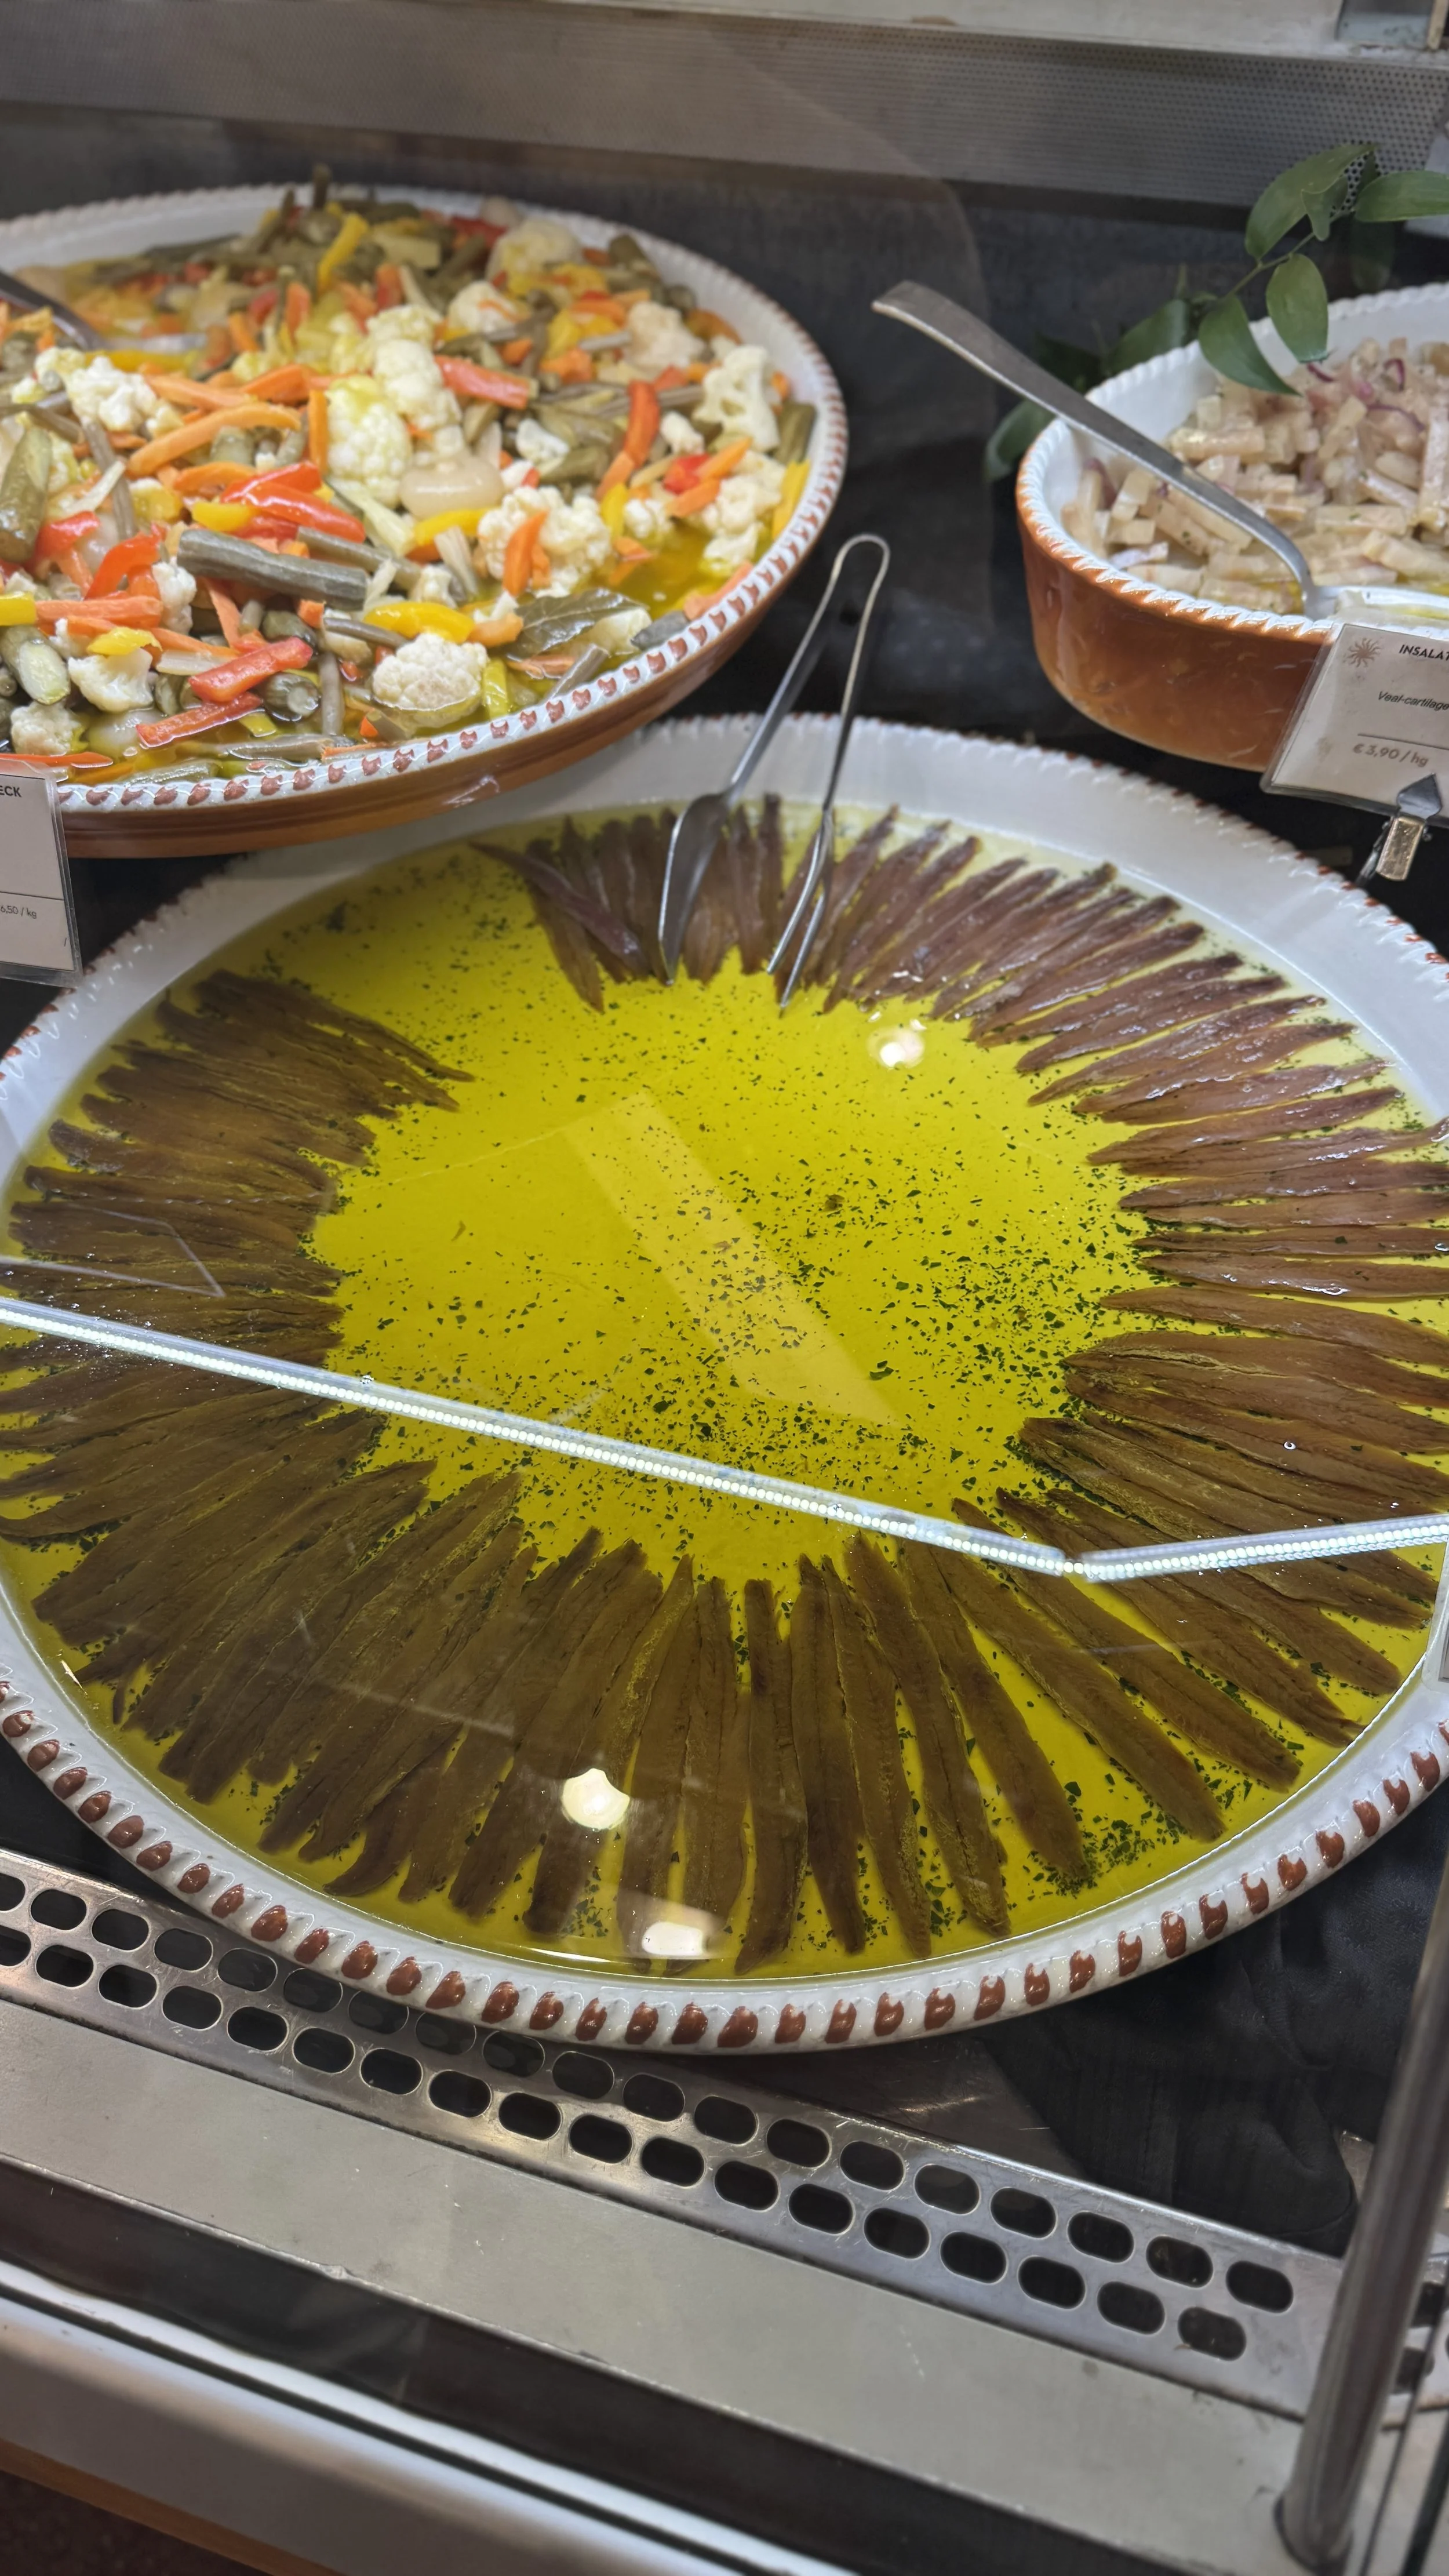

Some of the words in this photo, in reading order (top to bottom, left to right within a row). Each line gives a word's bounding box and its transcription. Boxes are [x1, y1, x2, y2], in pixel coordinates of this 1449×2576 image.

[1378, 691, 1449, 711] Veal-cartilage
[1353, 743, 1364, 754] €
[1365, 745, 1400, 759] 3,90
[27, 908, 37, 919] kg
